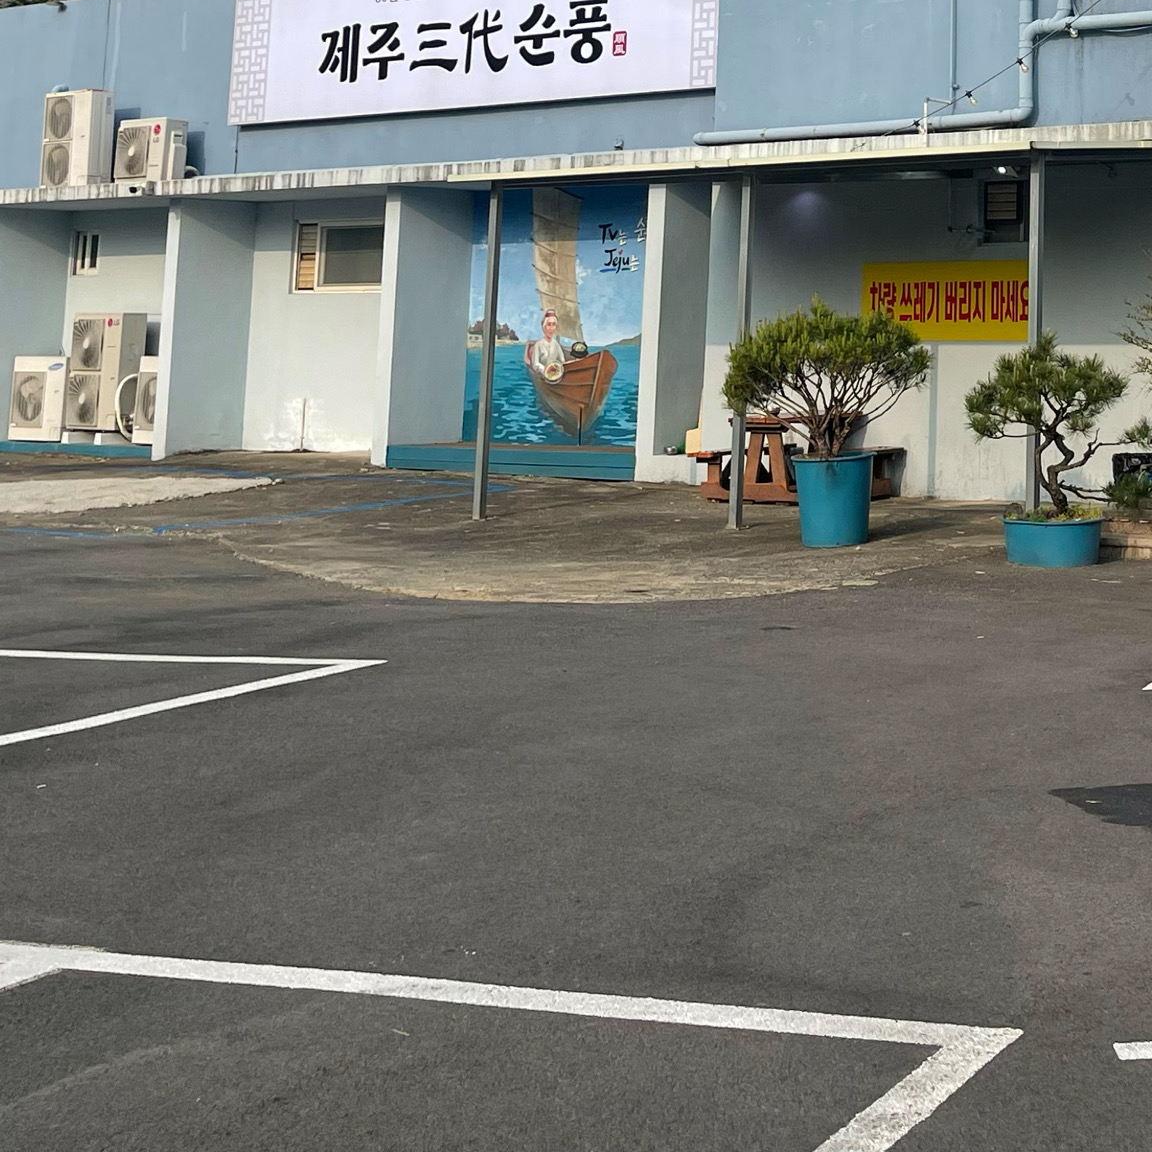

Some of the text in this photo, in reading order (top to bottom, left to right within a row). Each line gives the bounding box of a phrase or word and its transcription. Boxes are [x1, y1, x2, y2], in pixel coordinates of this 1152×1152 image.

[598, 223, 628, 246] Tv는
[603, 248, 640, 274] Jeju는
[899, 281, 940, 323] 쓰레기
[944, 281, 986, 323] 버리지
